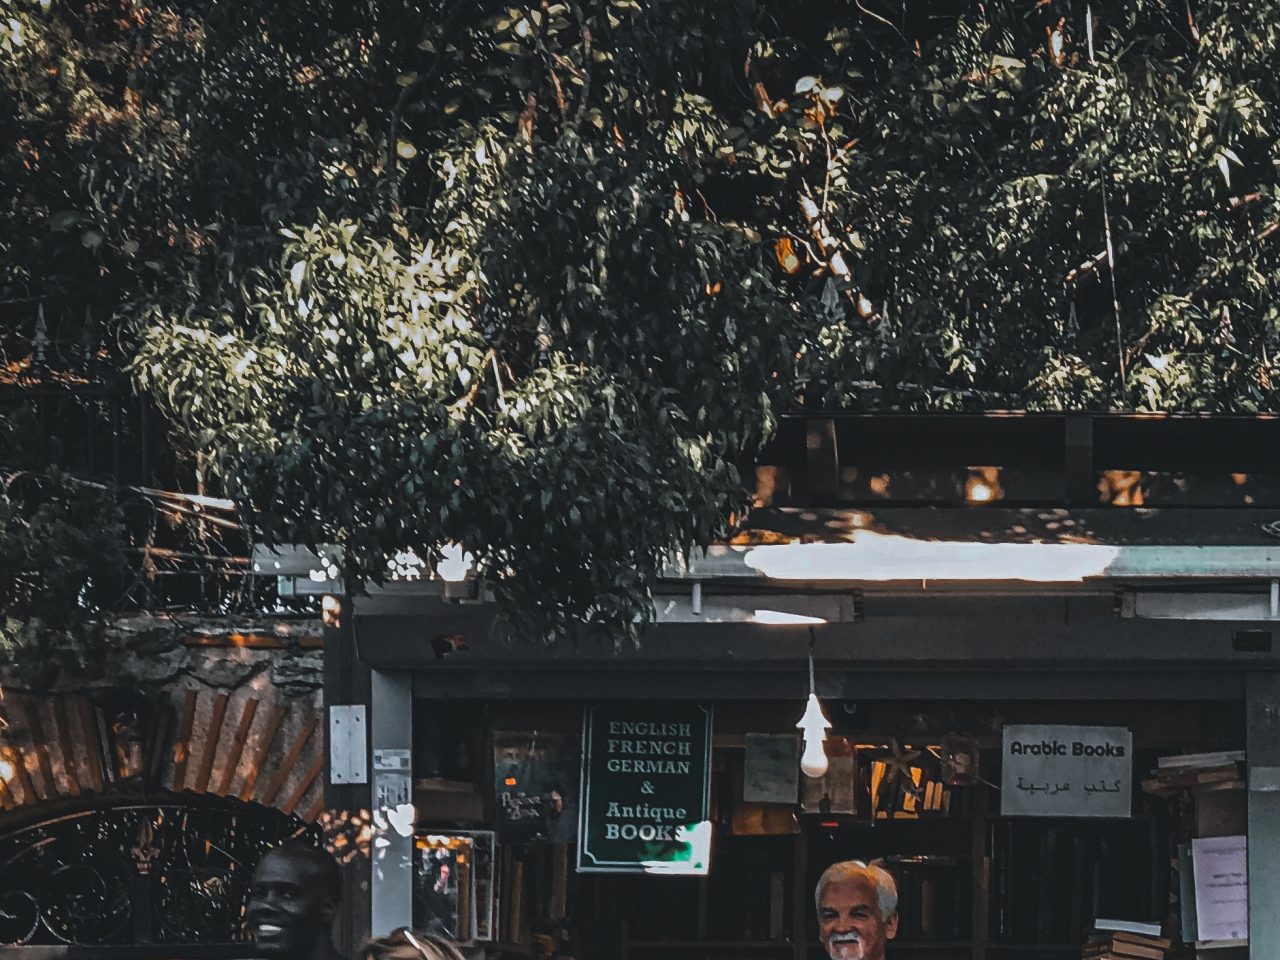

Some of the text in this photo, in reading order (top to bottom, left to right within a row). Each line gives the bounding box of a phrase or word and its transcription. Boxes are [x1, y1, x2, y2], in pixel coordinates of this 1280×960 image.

[608, 721, 692, 737] ENGLISH
[607, 739, 692, 756] FRENCH
[1010, 740, 1126, 758] Arabic Books
[607, 759, 690, 775] GERMAN
[640, 780, 656, 794] &
[605, 802, 687, 822] Antique
